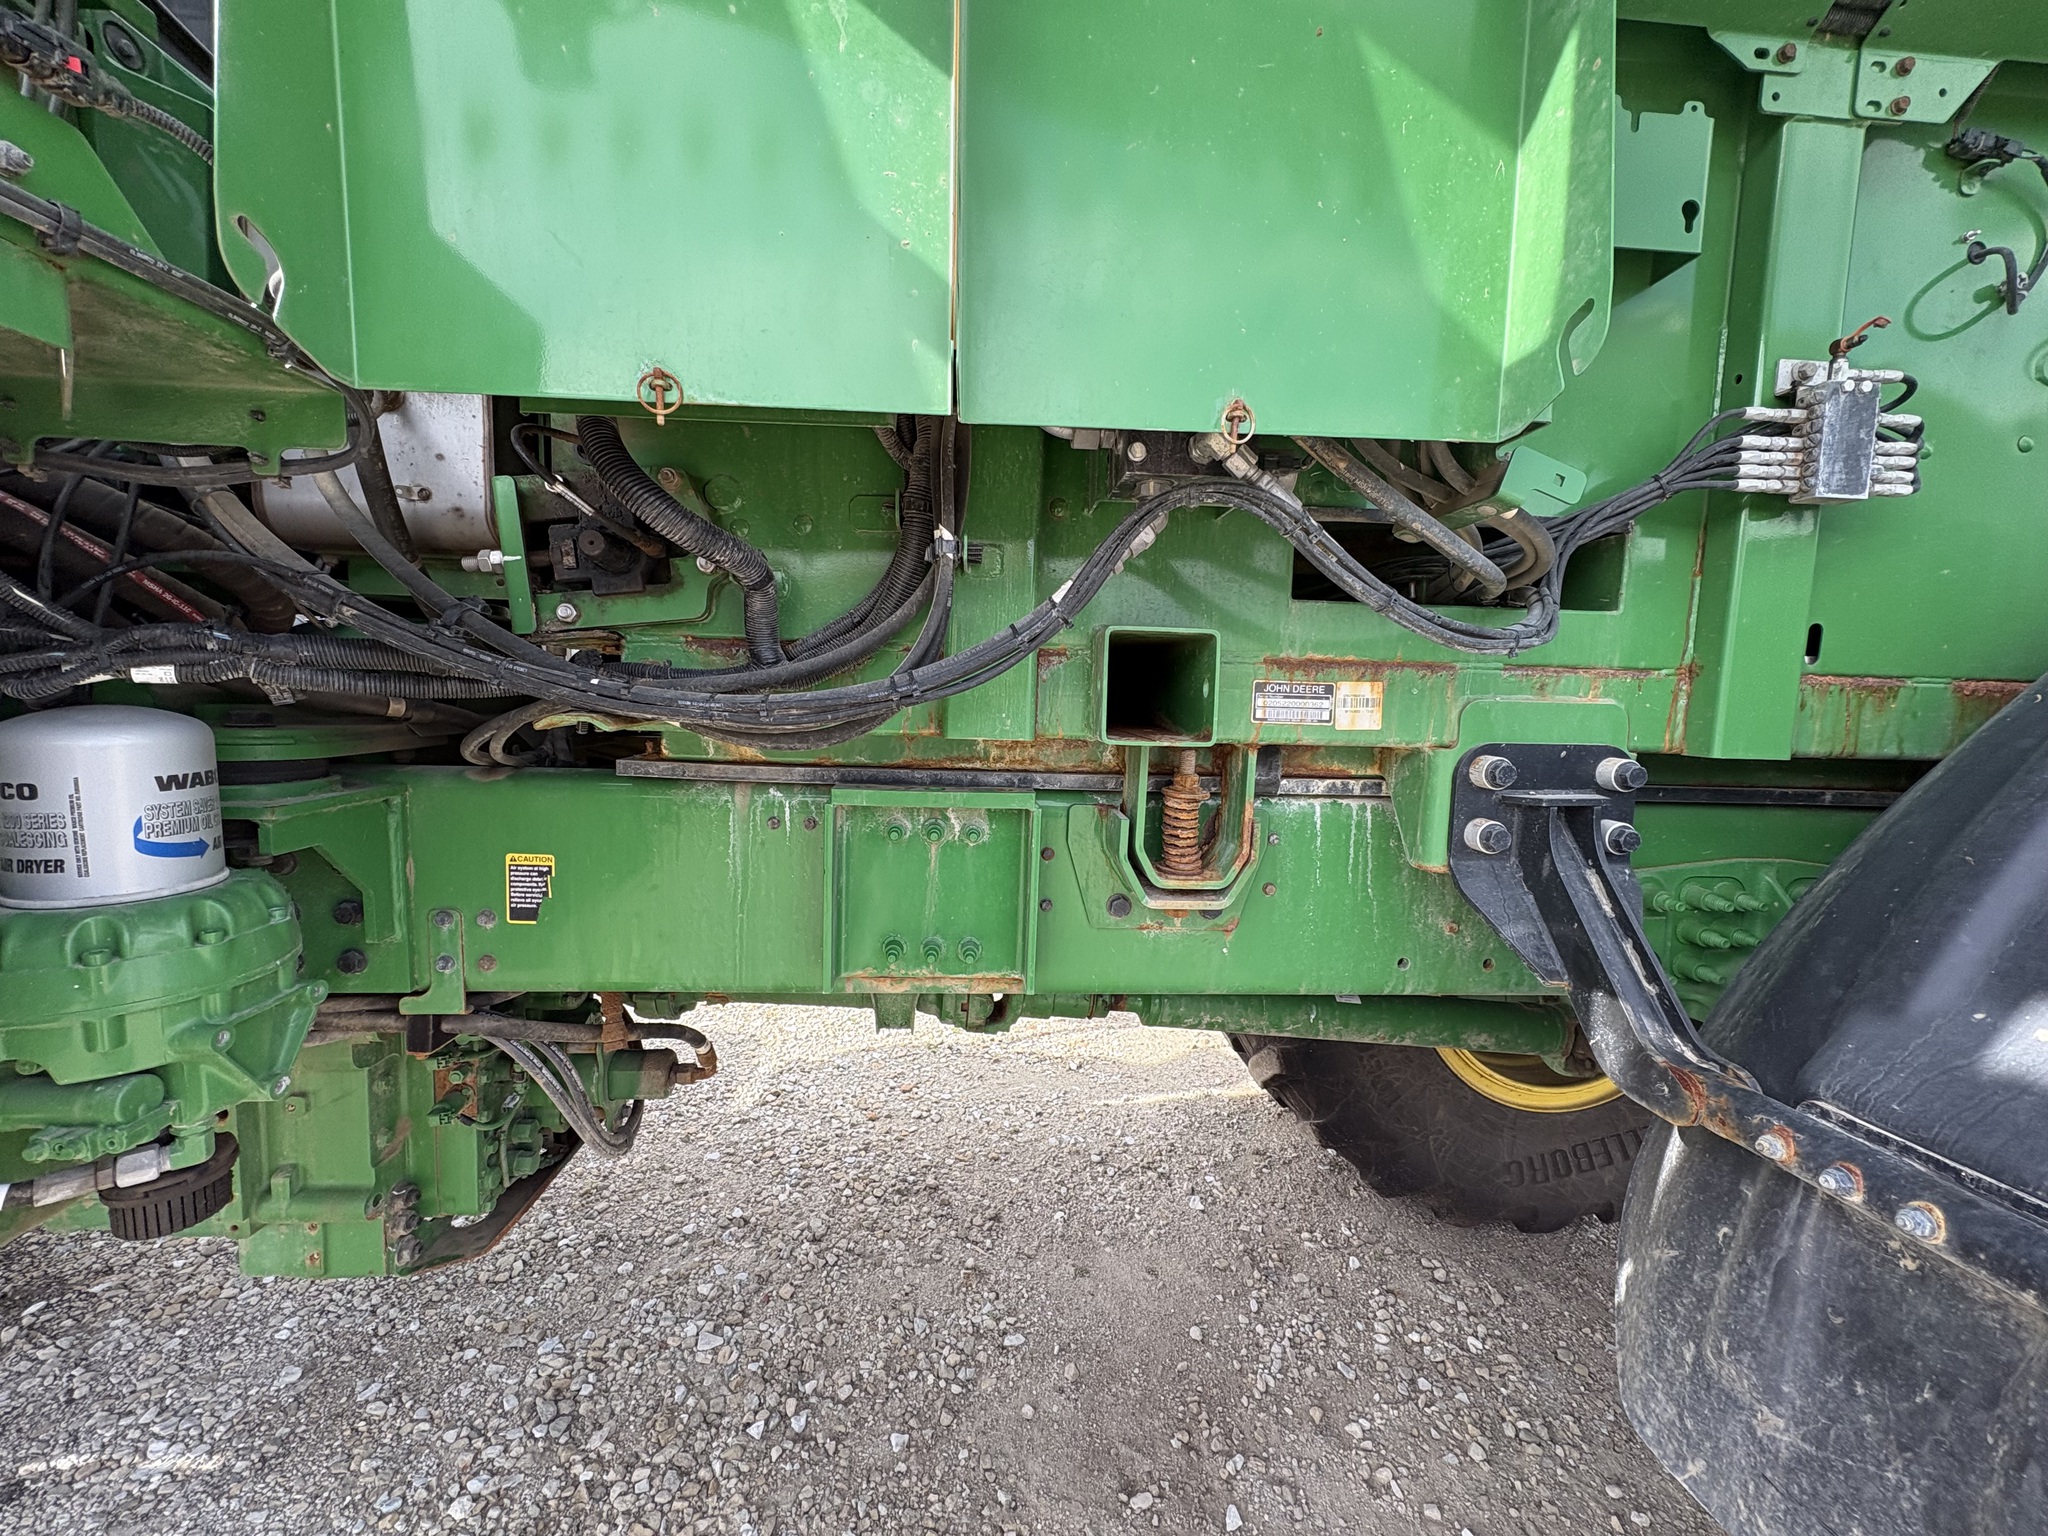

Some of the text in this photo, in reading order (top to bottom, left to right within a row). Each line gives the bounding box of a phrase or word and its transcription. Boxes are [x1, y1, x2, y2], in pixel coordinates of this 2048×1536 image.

[142, 579, 163, 594] MSHA
[1263, 683, 1326, 694] JOHN DEERE
[154, 769, 218, 792] WAB
[144, 800, 192, 821] SYSTEM
[24, 812, 67, 830] SERIES
[144, 815, 200, 839] PREMIUM
[201, 814, 213, 830] OIL
[16, 859, 66, 874] DRYER
[517, 855, 553, 863] CAUTION
[1502, 1124, 1650, 1188] LLEBORG
